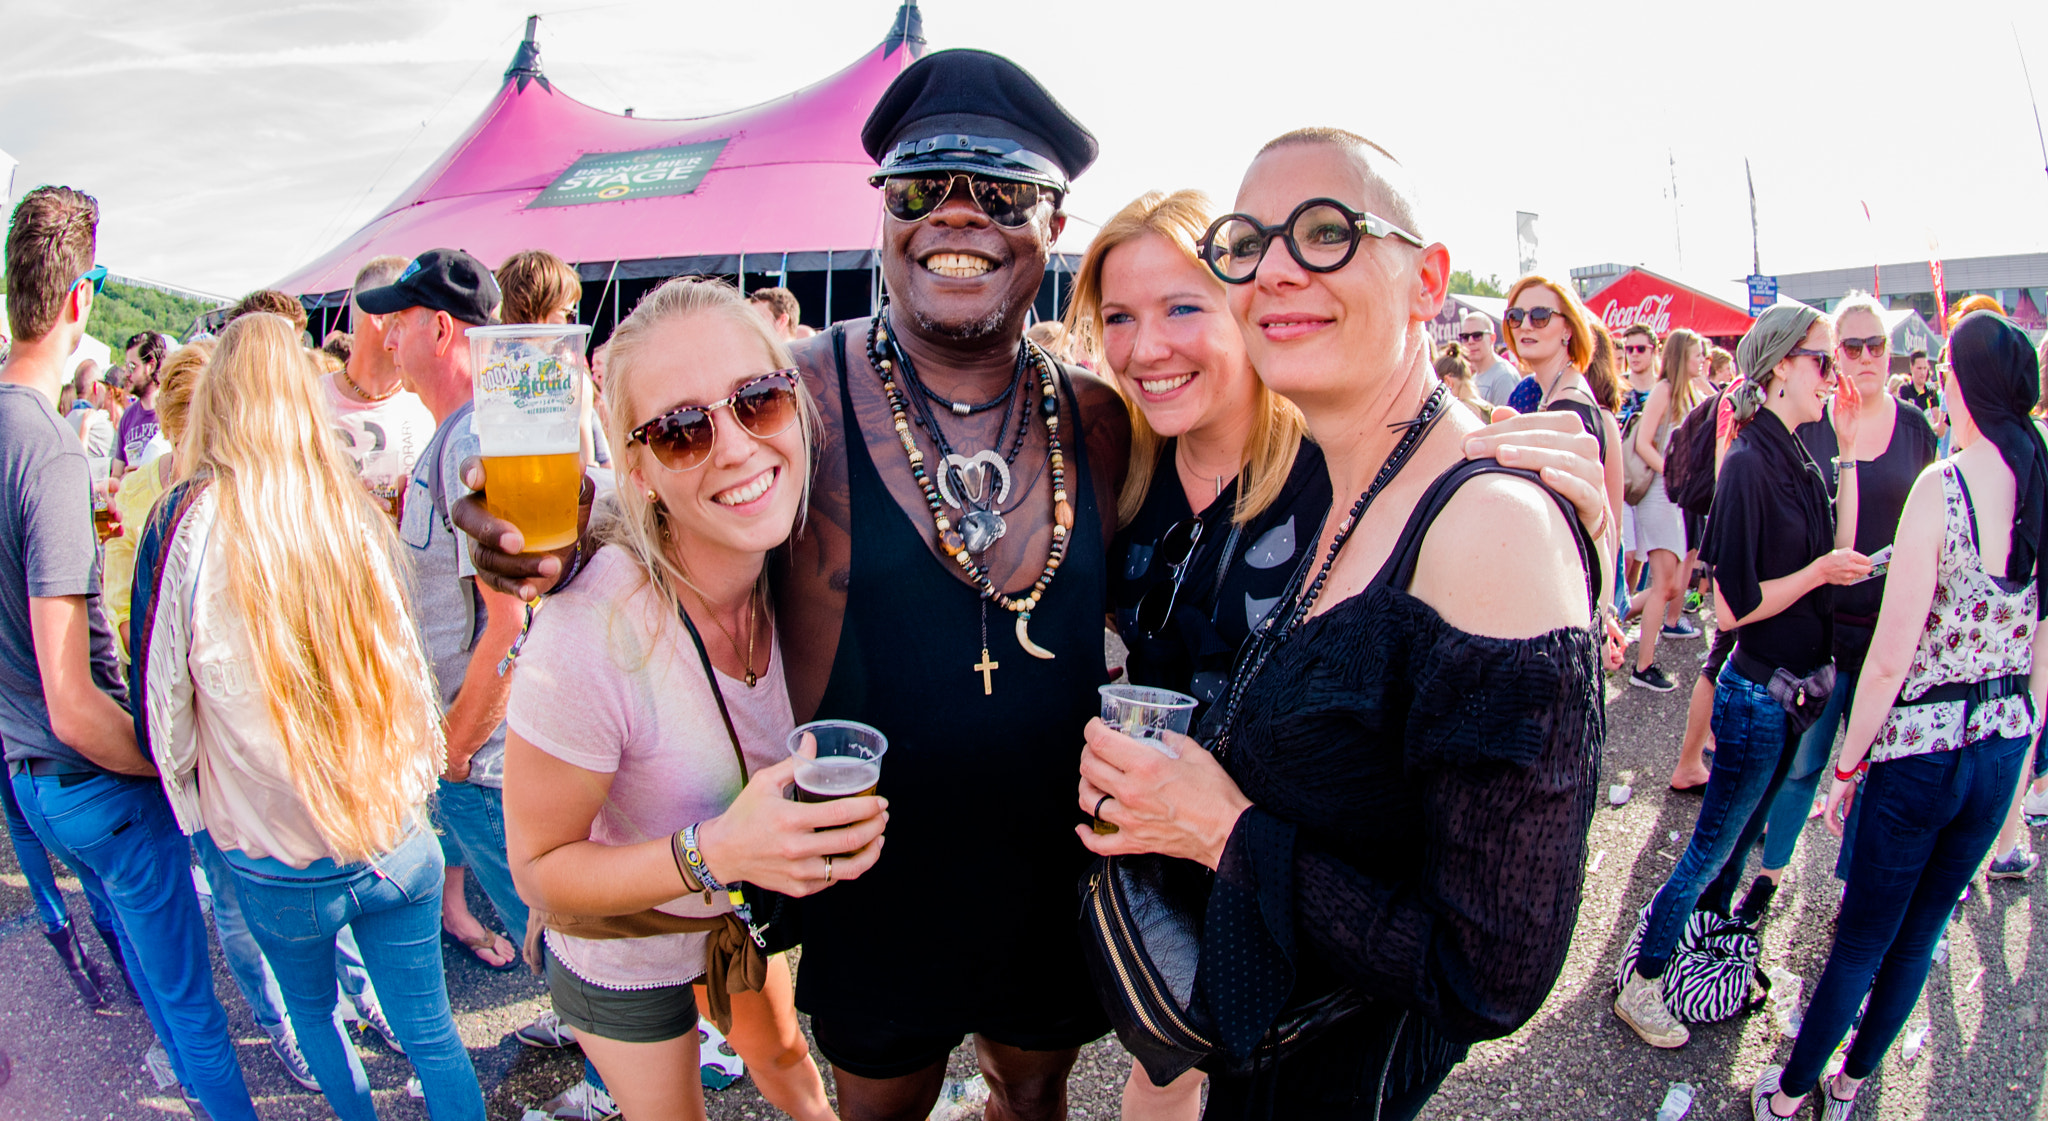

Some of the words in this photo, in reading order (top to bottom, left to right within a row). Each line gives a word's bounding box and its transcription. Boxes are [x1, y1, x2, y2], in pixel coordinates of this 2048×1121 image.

[557, 165, 697, 191] STAGE
[573, 163, 650, 177] BRAND
[654, 156, 703, 169] BIER
[1428, 318, 1462, 342] Bran
